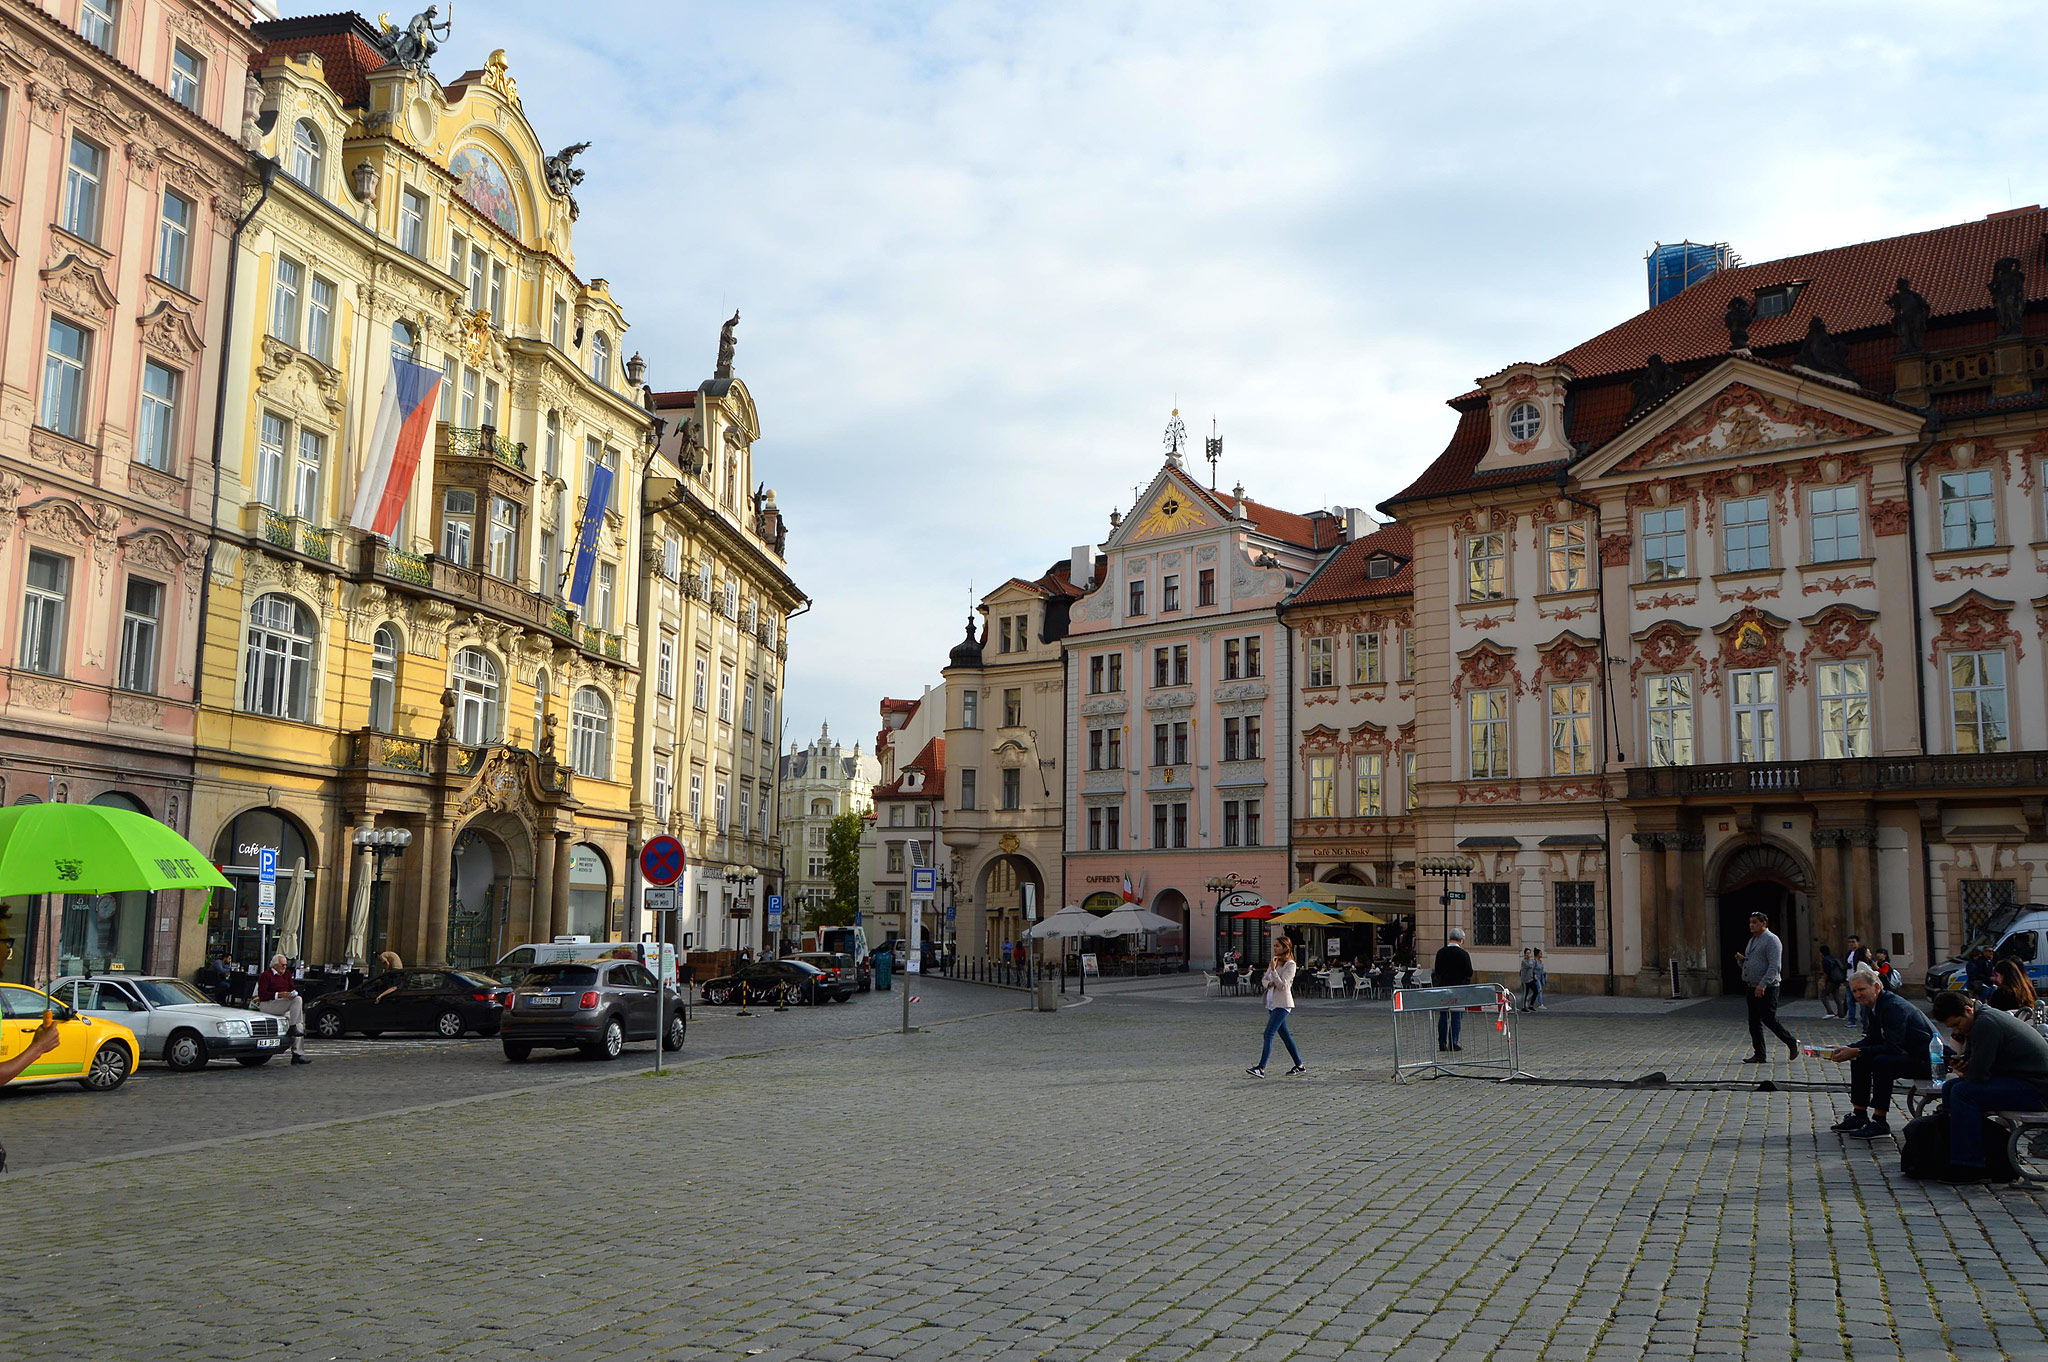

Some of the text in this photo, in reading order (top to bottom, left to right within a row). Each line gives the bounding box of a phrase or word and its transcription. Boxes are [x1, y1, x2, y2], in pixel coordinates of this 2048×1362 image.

[238, 843, 260, 857] Café
[1313, 847, 1330, 856] Café
[1331, 848, 1343, 856] NG
[153, 858, 199, 879] HOP OFF
[263, 853, 273, 872] P
[1086, 875, 1120, 883] CAFFREY'S
[771, 897, 780, 909] P
